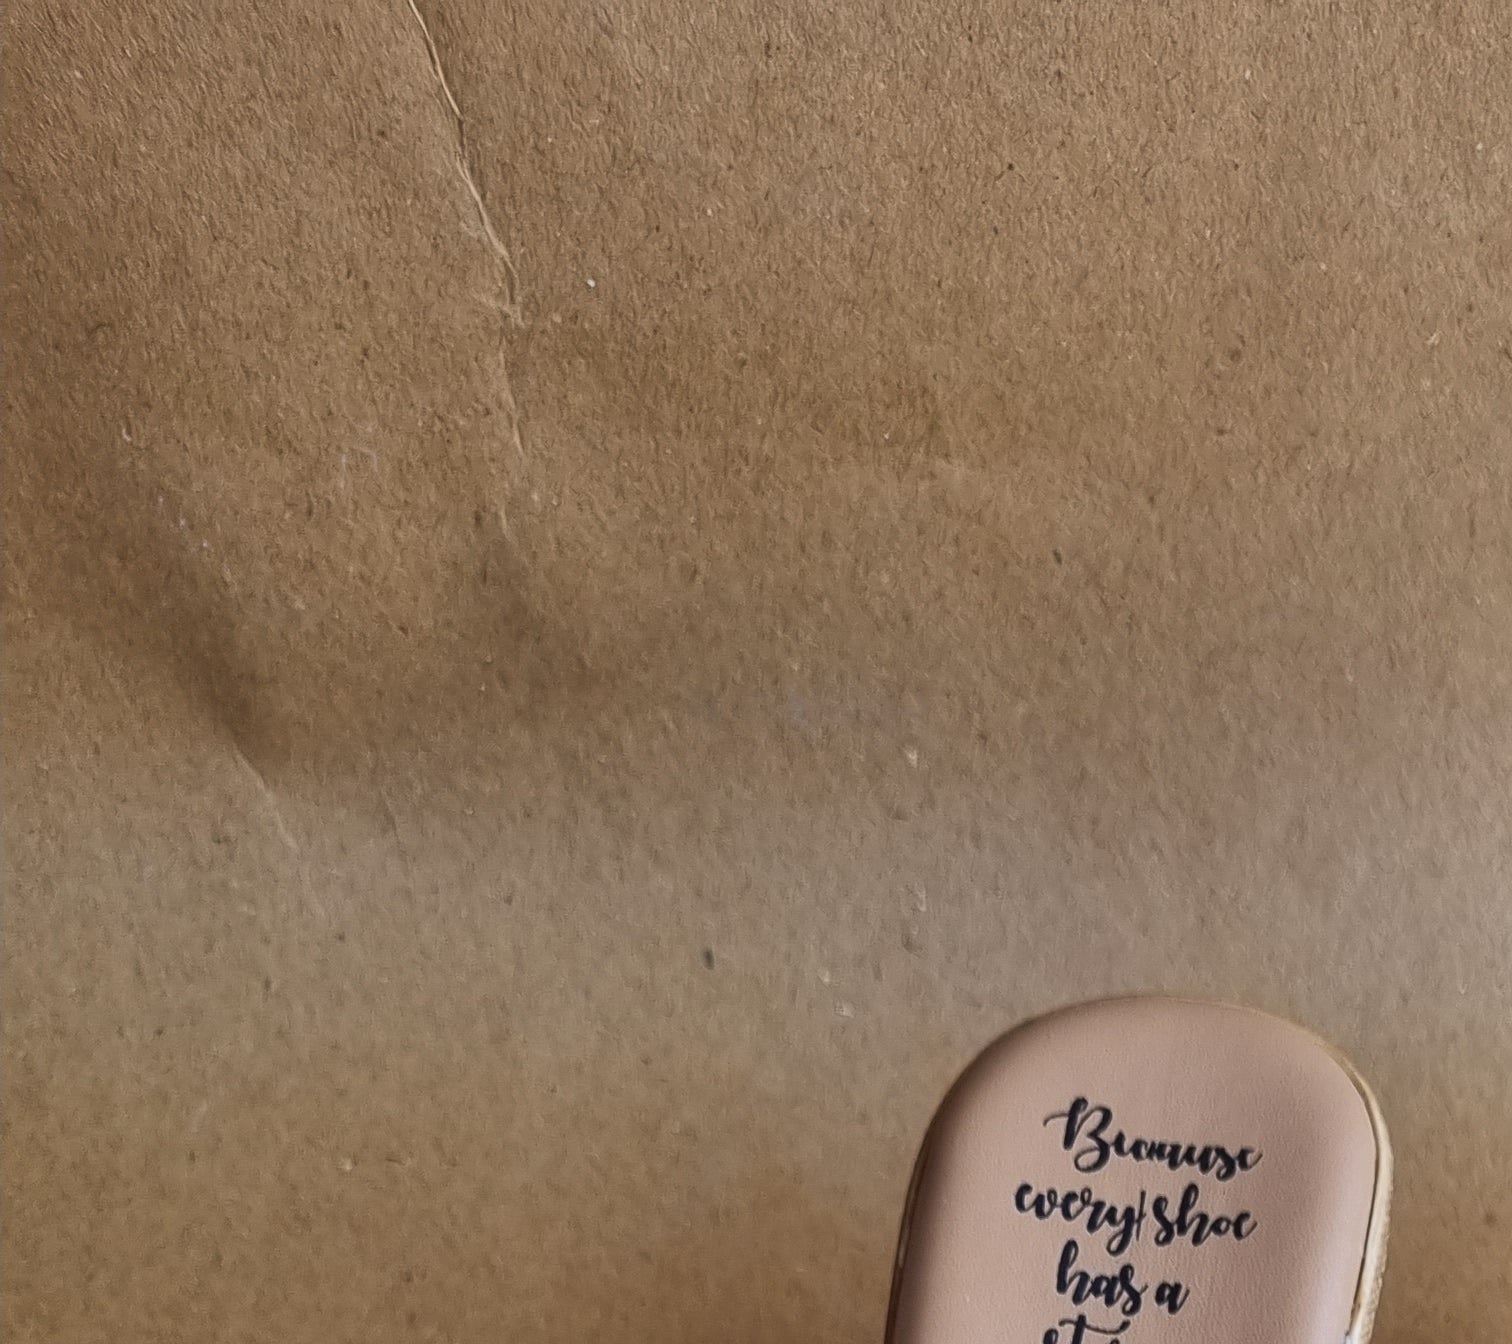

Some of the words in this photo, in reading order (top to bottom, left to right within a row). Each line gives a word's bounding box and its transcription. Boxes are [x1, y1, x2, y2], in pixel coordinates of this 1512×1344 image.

[1043, 1097, 1264, 1182] Because
[1152, 1183, 1258, 1247] shoe
[1056, 1239, 1148, 1316] has
[1155, 1280, 1190, 1315] a
